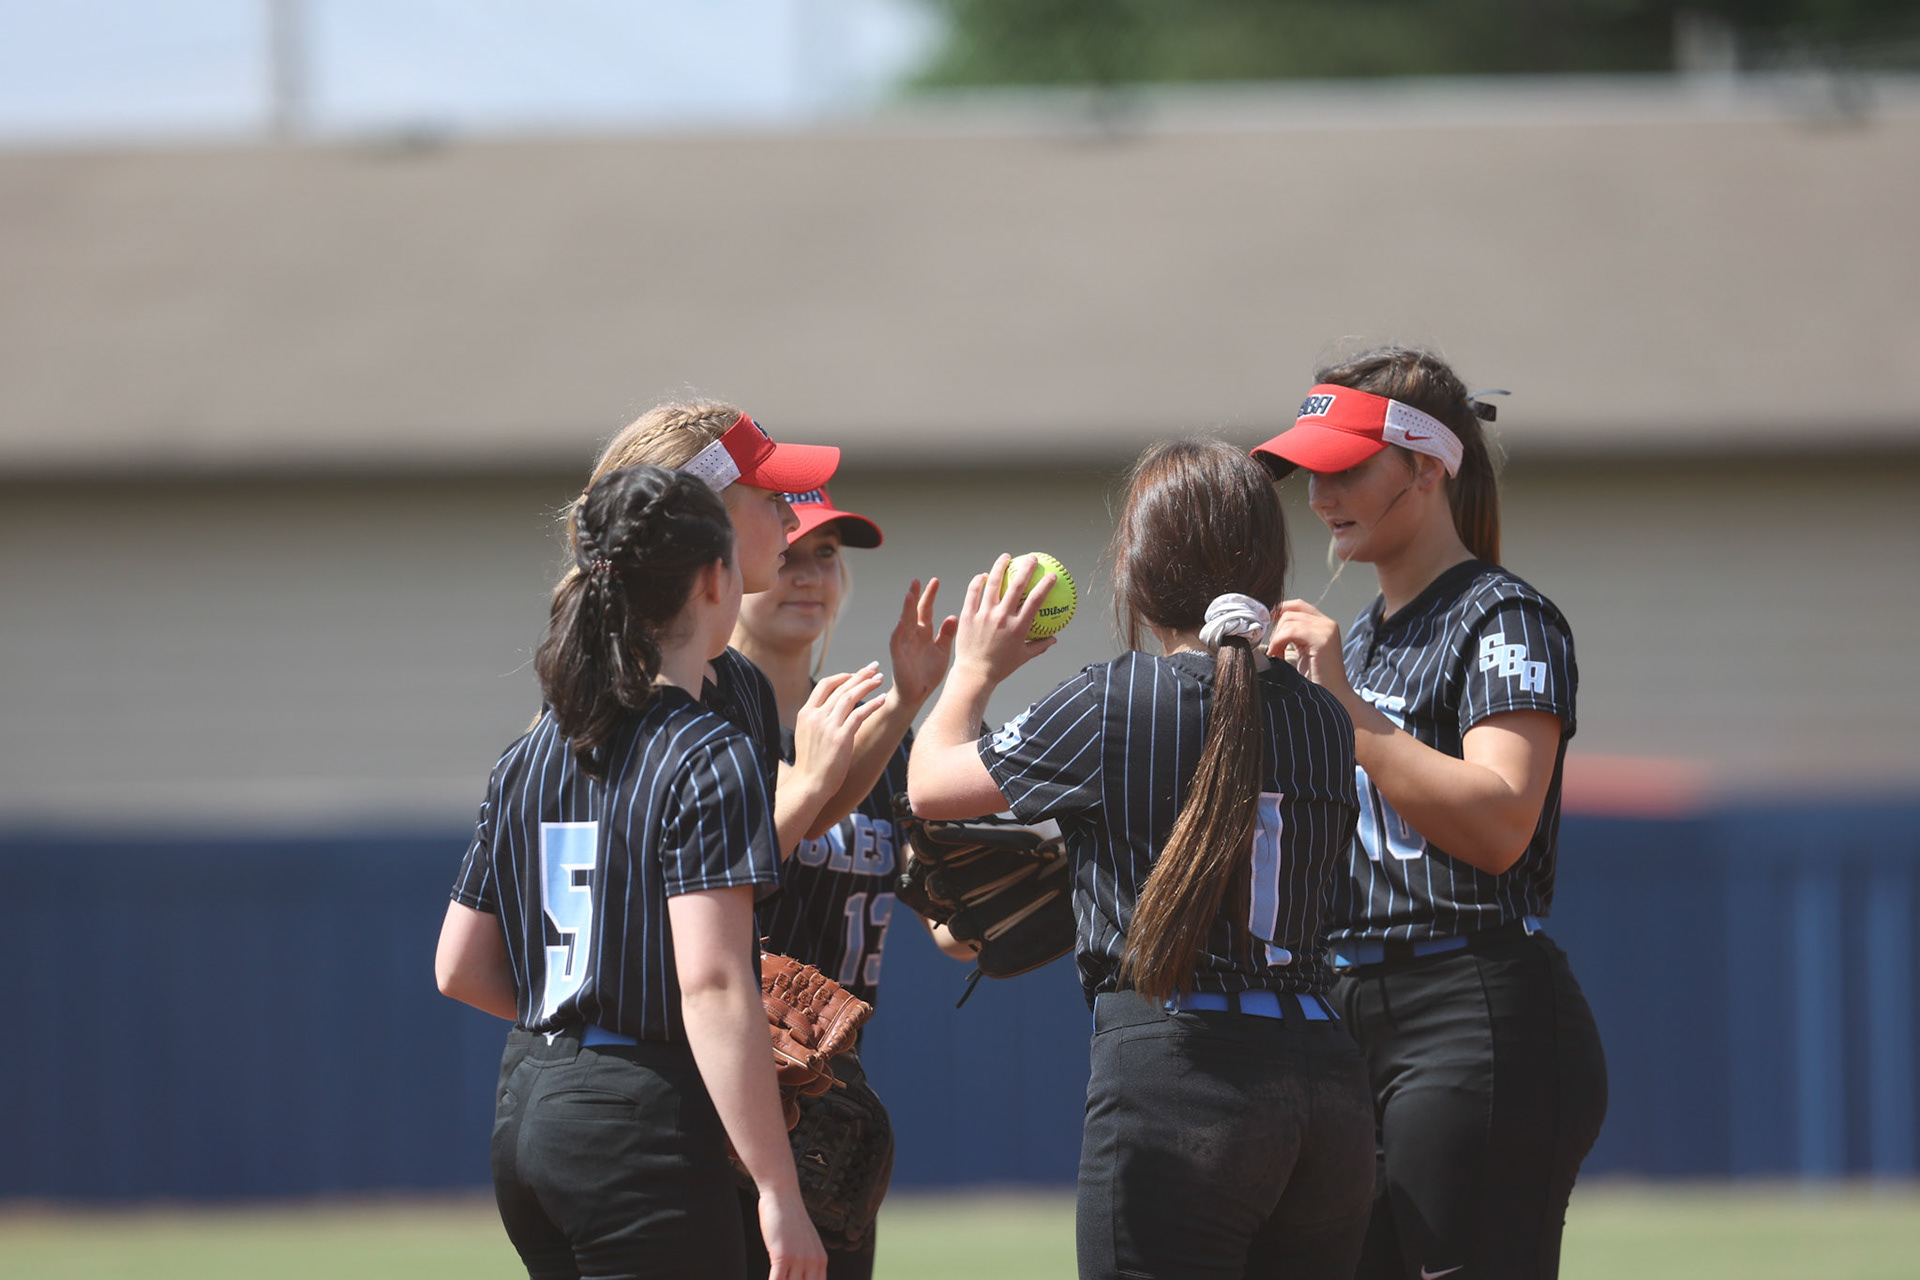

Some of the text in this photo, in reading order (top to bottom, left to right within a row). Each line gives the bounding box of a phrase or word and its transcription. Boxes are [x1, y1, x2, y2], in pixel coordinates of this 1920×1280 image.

[1039, 605, 1070, 617] Wilson
[1479, 632, 1547, 694] SBA
[540, 821, 599, 1019] 5
